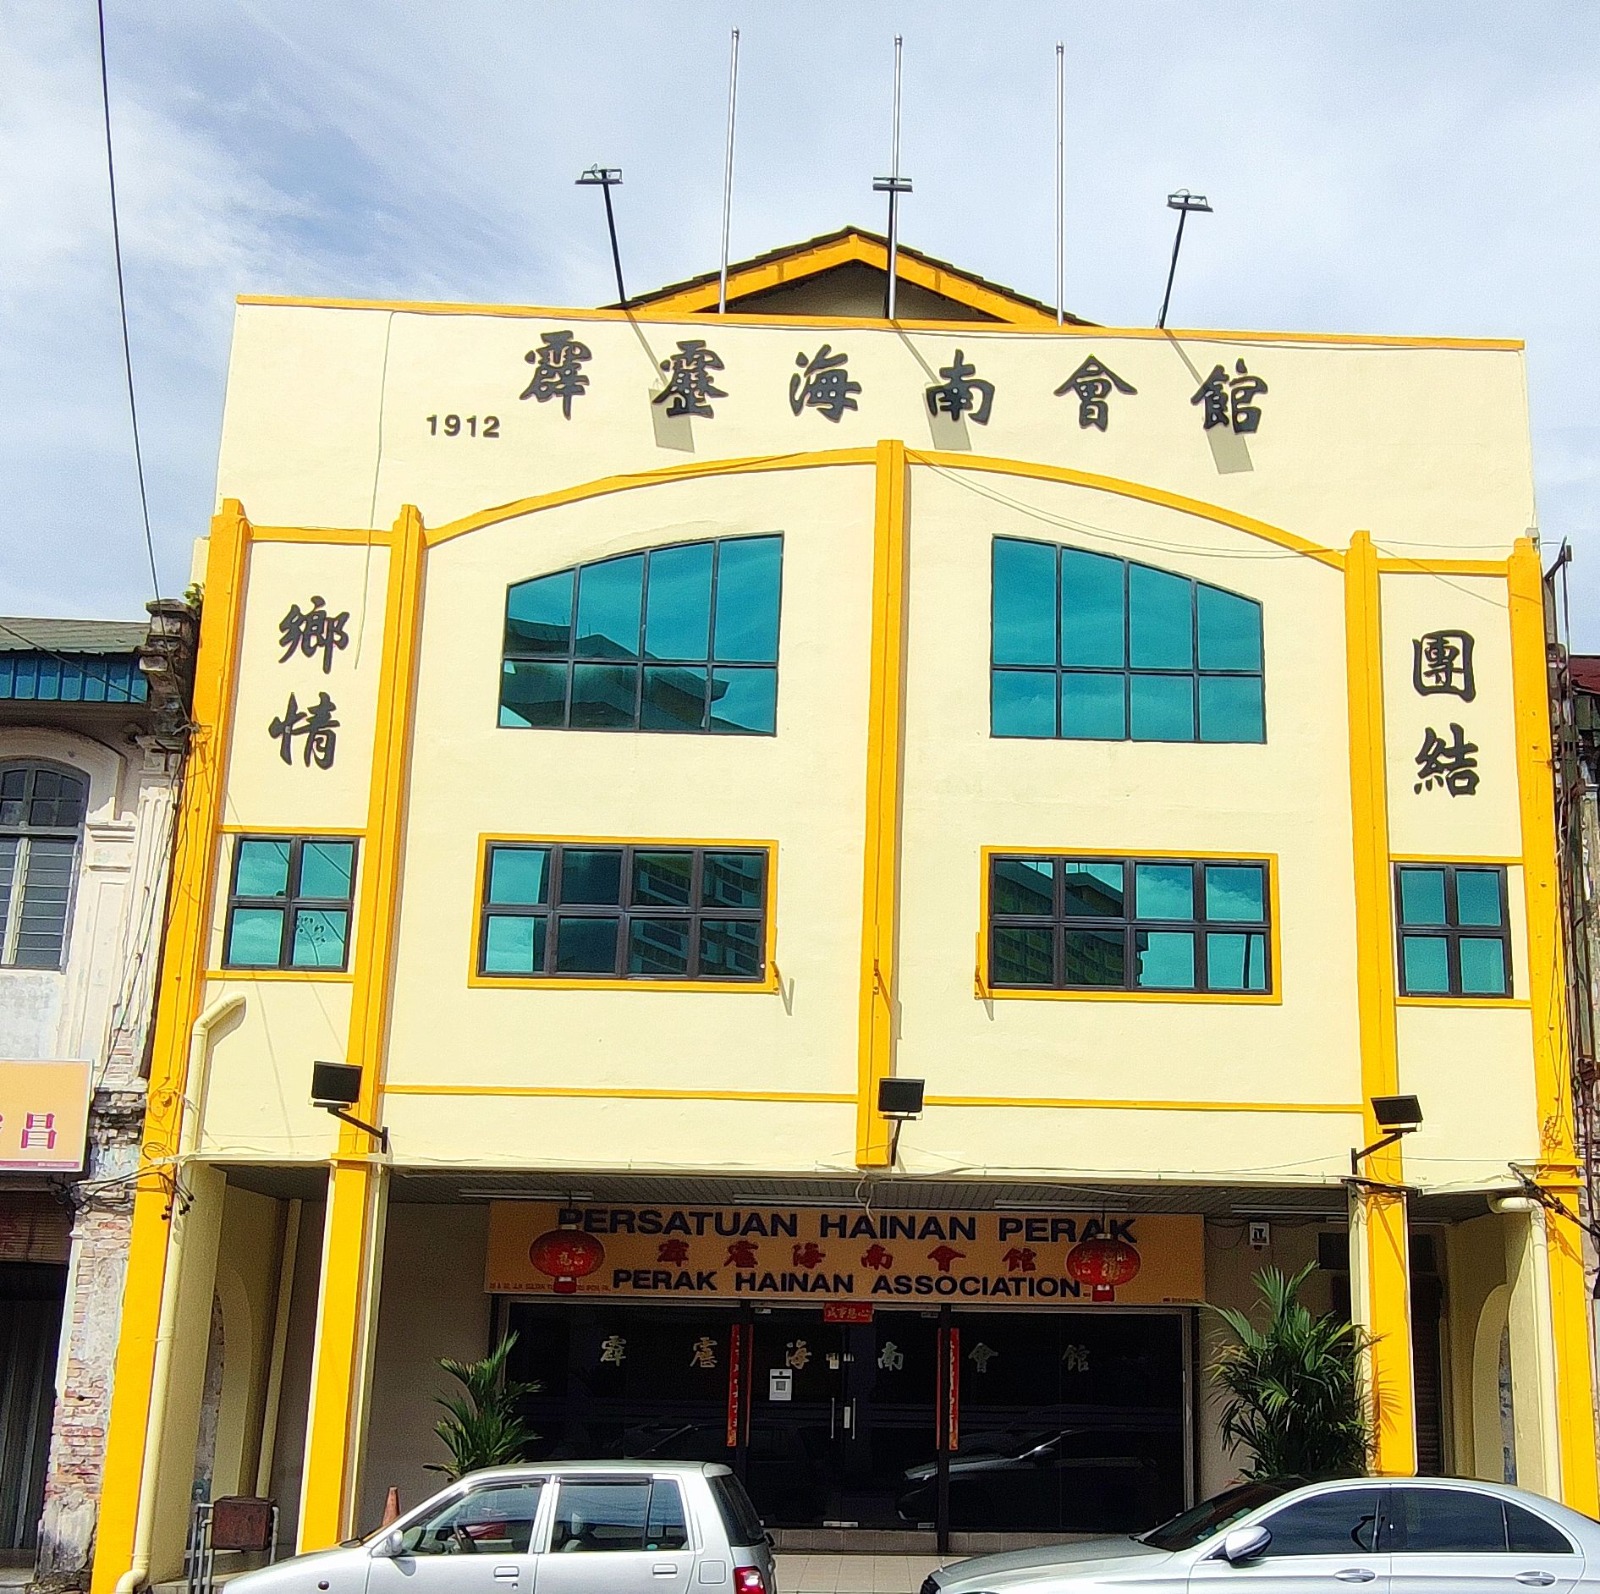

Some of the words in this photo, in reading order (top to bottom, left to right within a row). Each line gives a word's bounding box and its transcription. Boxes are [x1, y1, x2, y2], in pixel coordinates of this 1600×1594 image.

[426, 414, 500, 438] 1912
[268, 595, 350, 770] 鄉情
[1411, 629, 1480, 798] 團結
[558, 1207, 798, 1238] PERSATUAN
[819, 1213, 976, 1241] HAINAN
[1000, 1217, 1138, 1244] PERAK
[612, 1269, 718, 1292] PERAK
[735, 1272, 854, 1295] HAINAN
[871, 1275, 1081, 1299] ASSOCIATION
